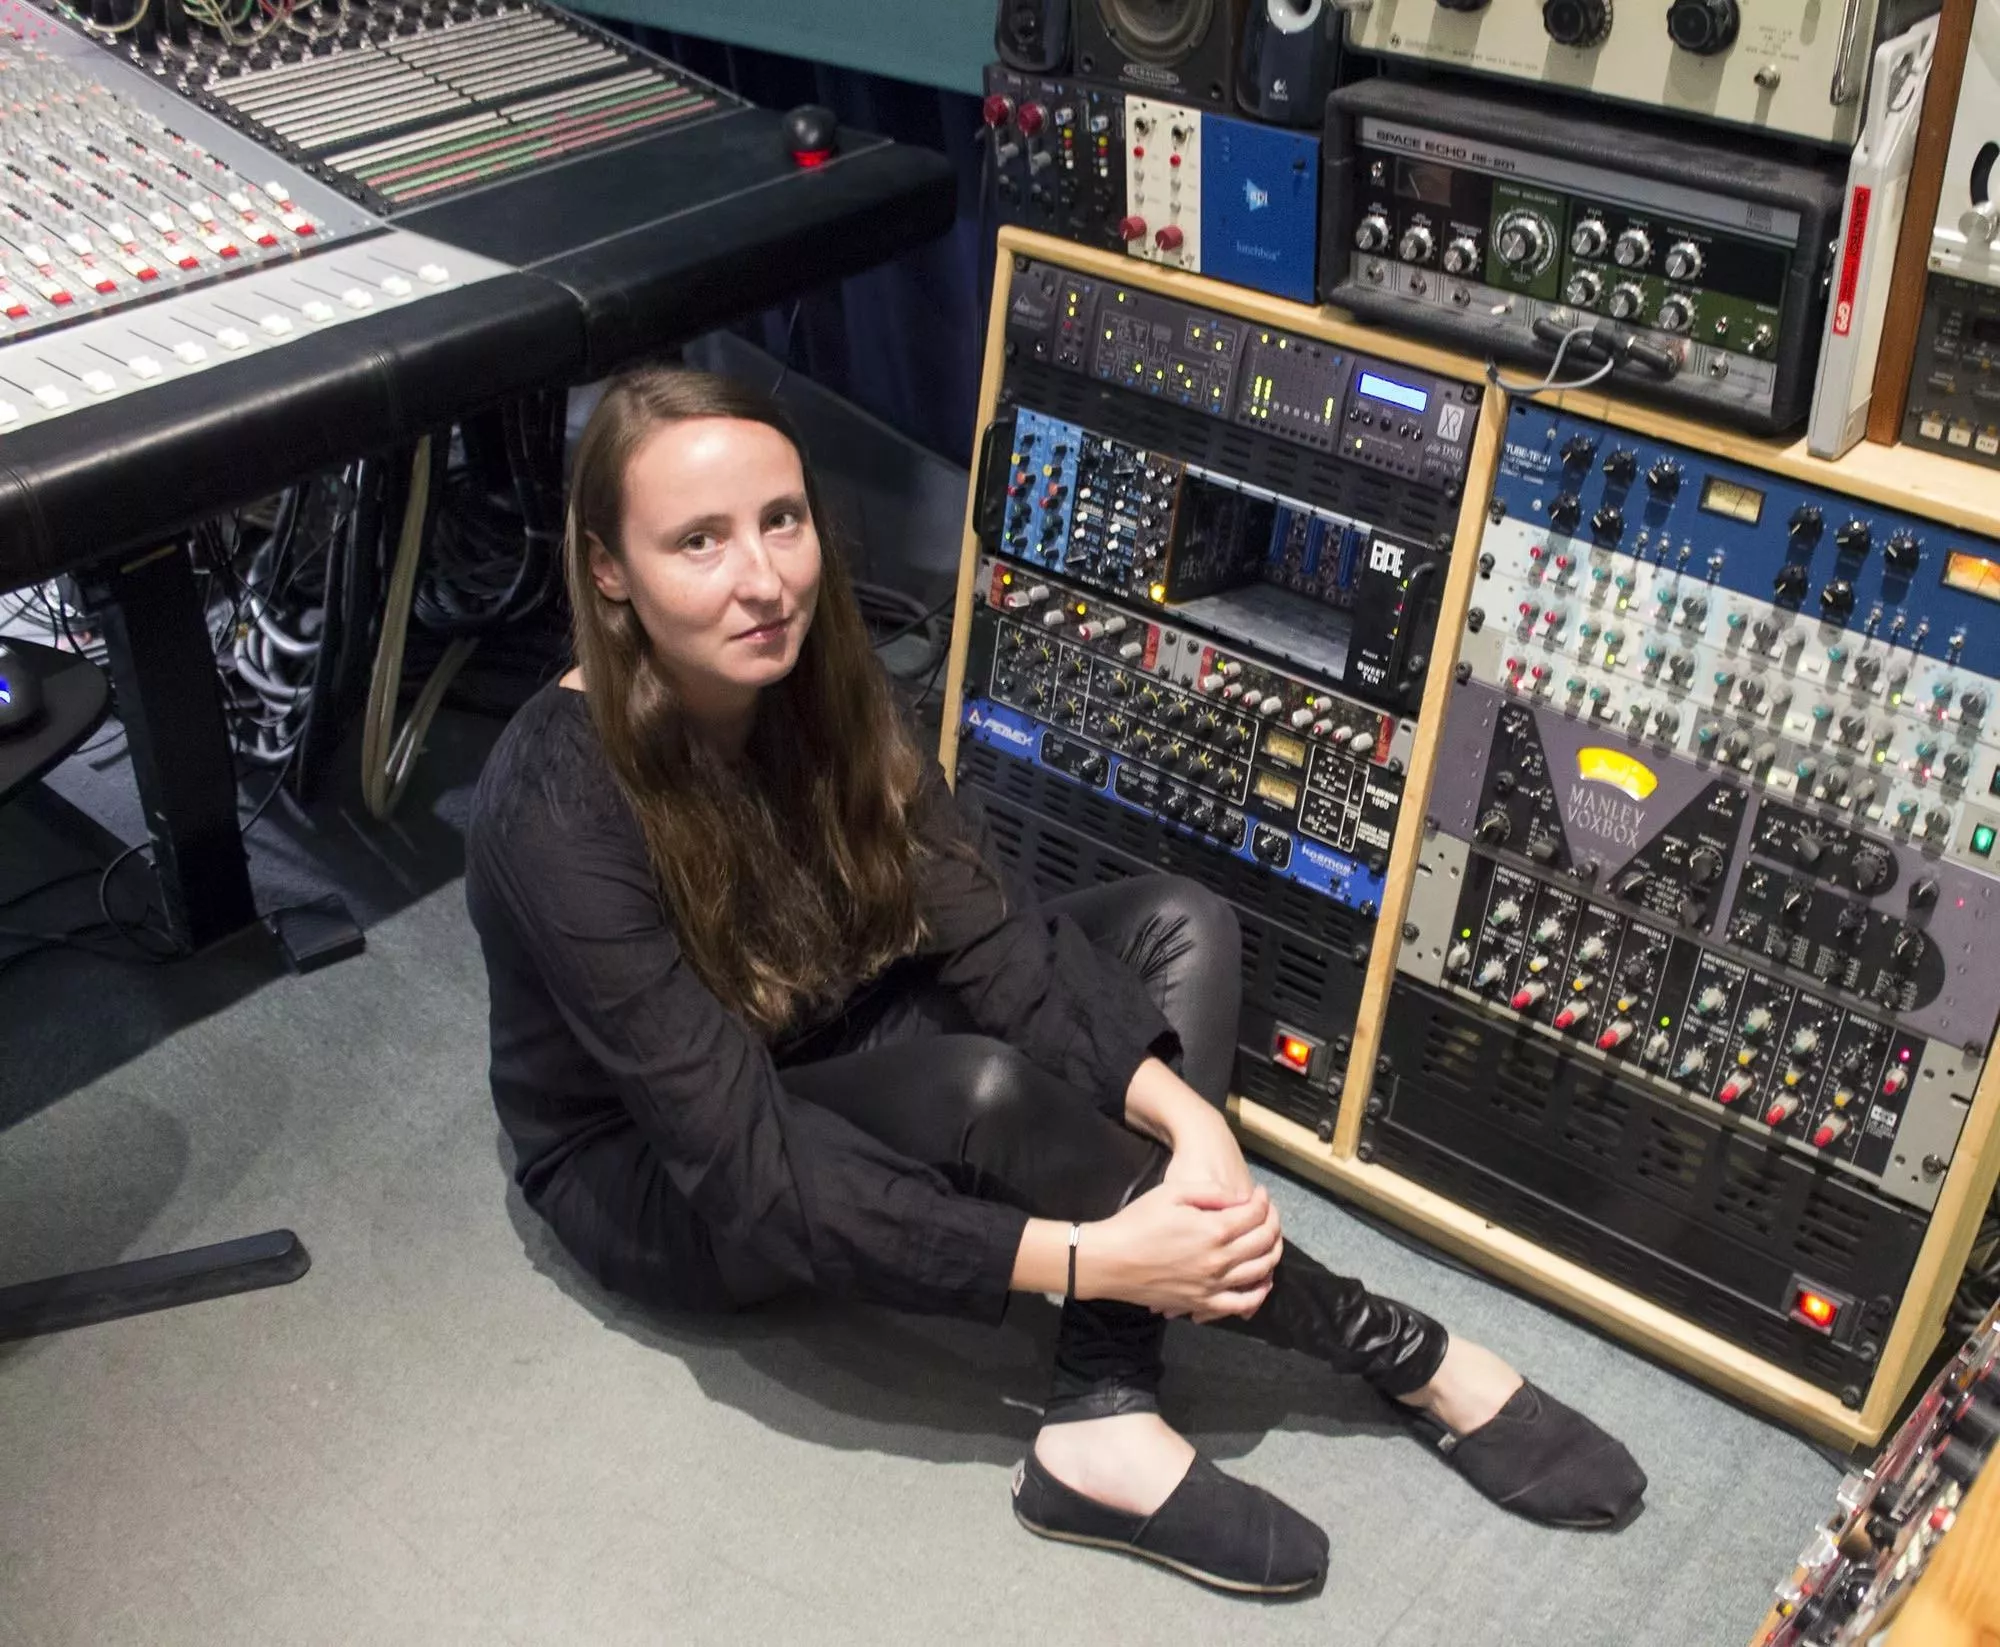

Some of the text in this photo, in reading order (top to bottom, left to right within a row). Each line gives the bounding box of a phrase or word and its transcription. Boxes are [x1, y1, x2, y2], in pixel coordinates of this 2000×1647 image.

[1376, 129, 1421, 149] SPACE
[1425, 137, 1467, 159] ECHO
[1567, 804, 1640, 849] VOXBOX
[1569, 784, 1647, 828] MANLEY
